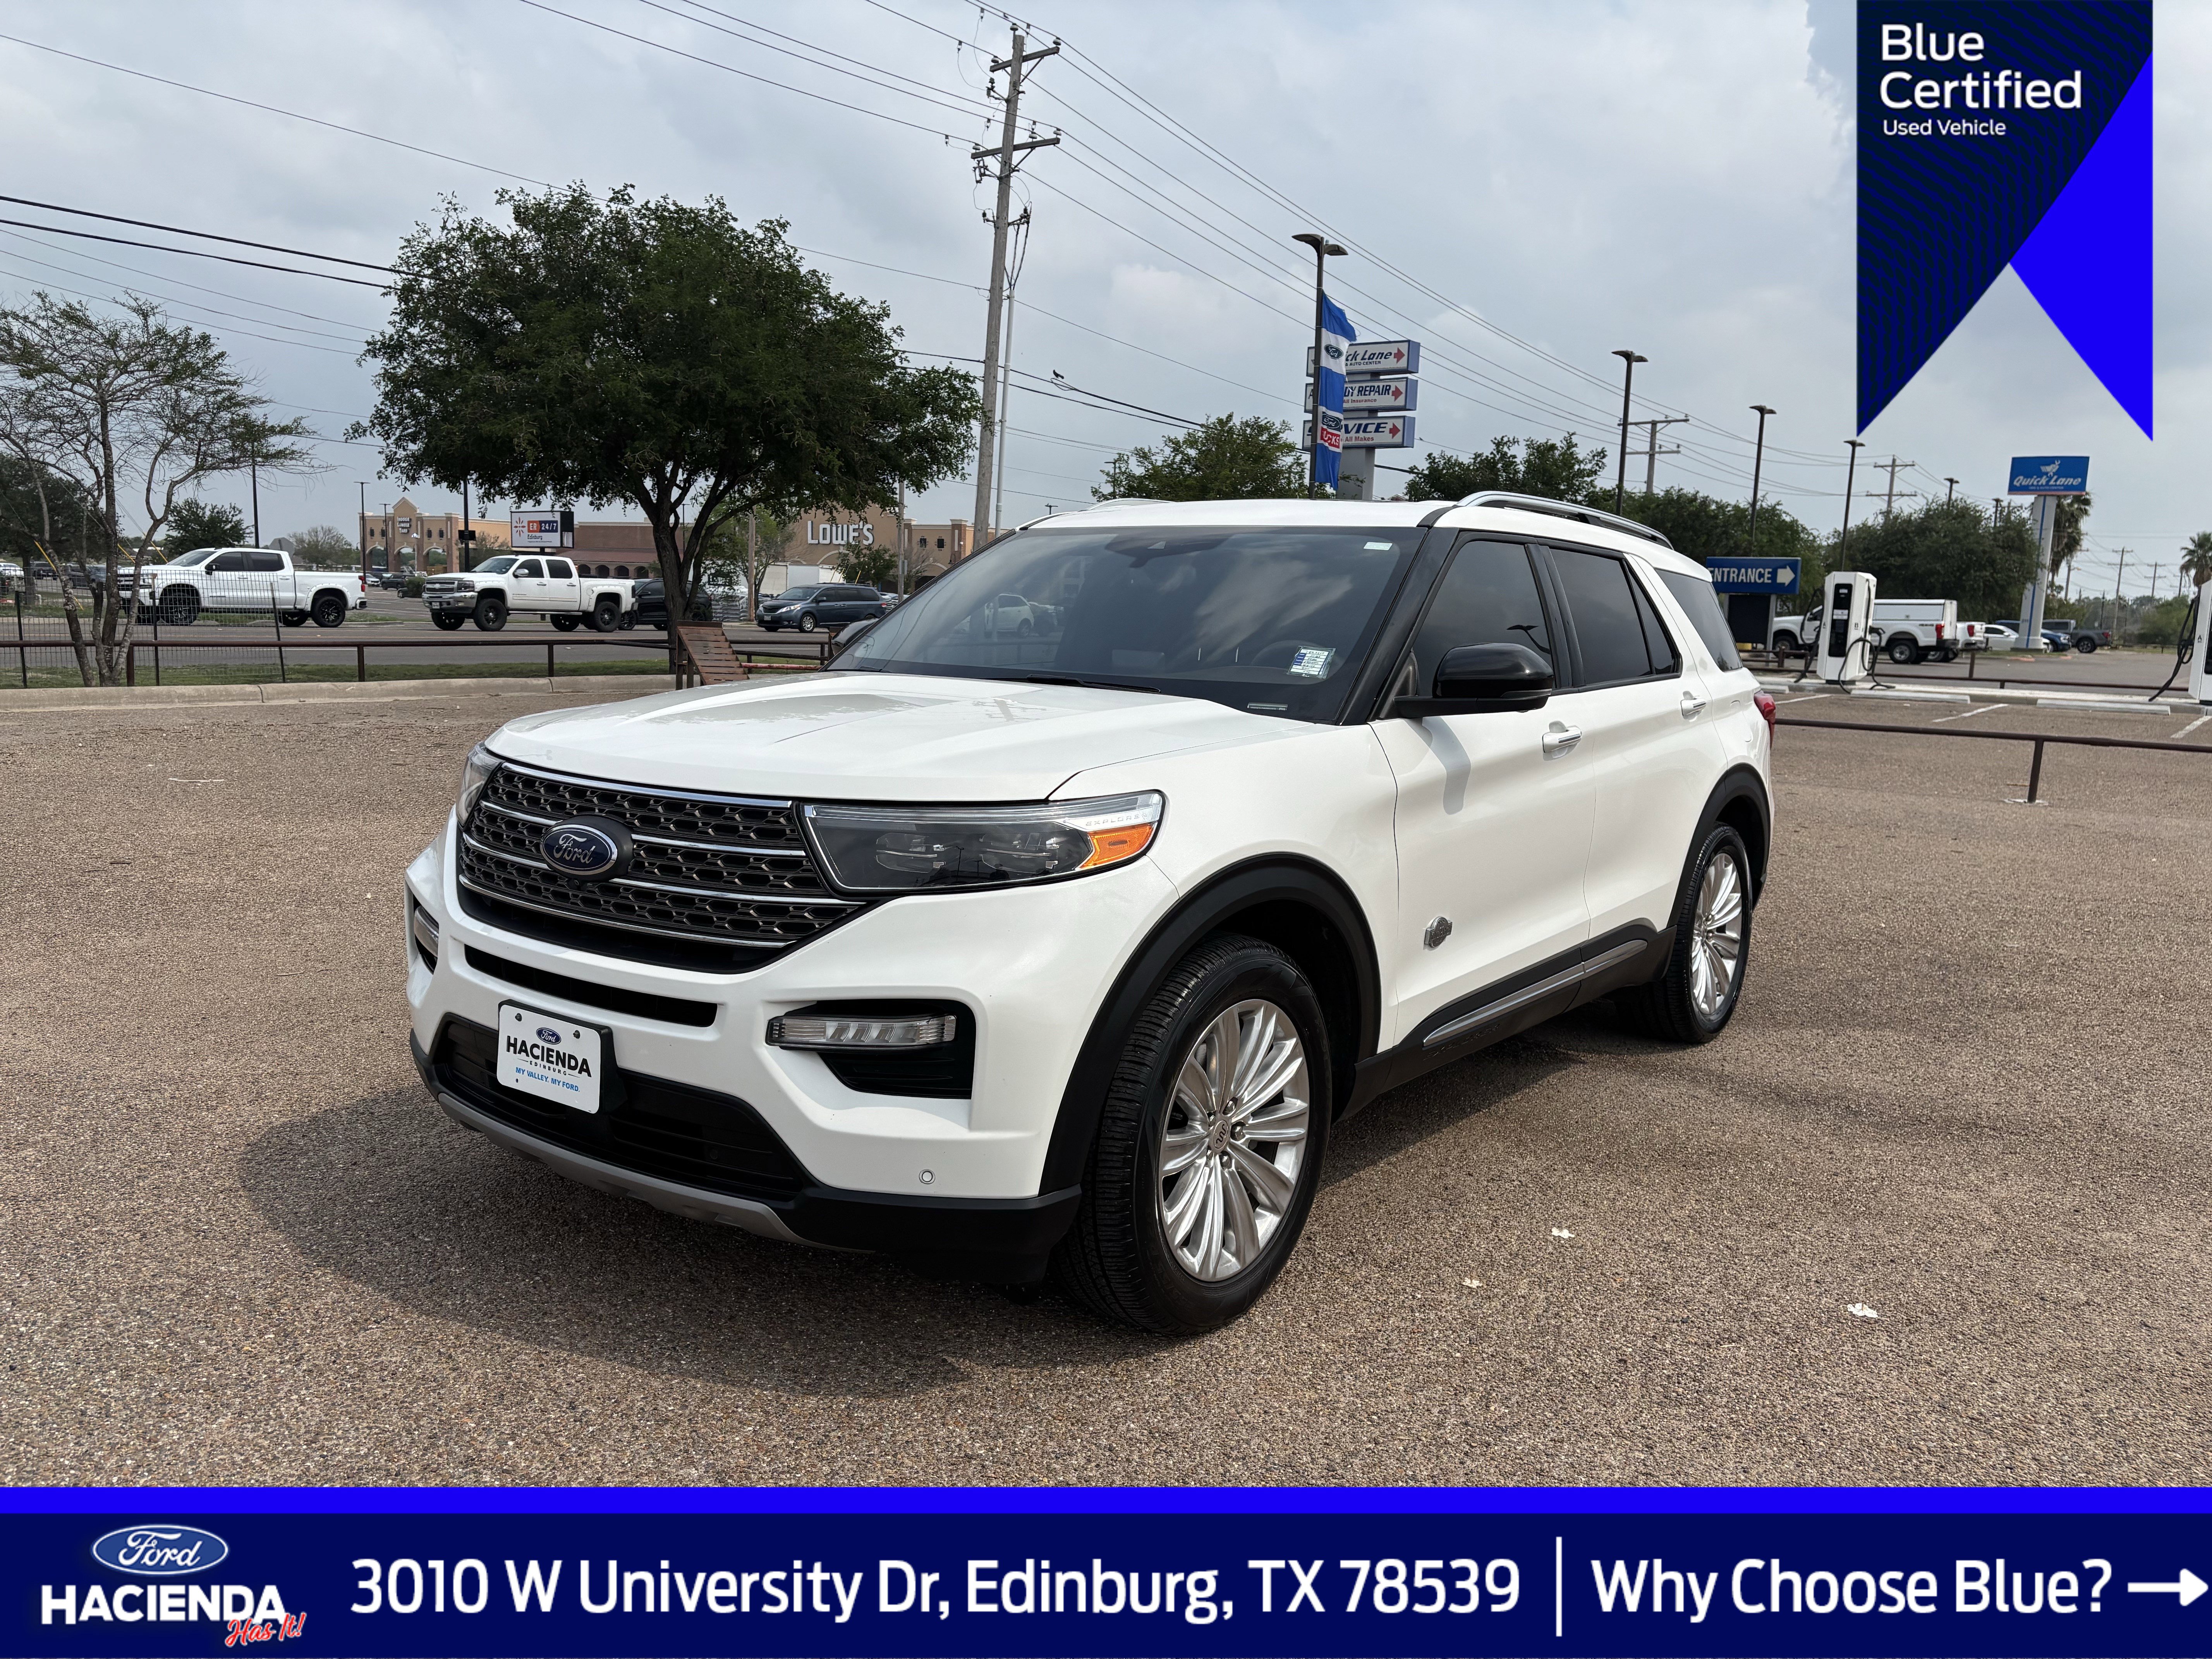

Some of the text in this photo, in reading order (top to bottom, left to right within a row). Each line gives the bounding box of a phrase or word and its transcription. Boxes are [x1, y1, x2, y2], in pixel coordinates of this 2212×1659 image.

[1361, 350, 1393, 361] Lane
[1344, 385, 1391, 397] DY REPAIR
[2014, 475, 2081, 487] Quick Lane
[807, 520, 874, 545] LOWE'S
[1085, 812, 1147, 826] EXPLORER
[553, 833, 596, 864] Ford
[506, 1035, 592, 1078] HACIENDA
[530, 1060, 567, 1076] EDINBURG
[515, 1067, 526, 1075] MY
[551, 1078, 561, 1086] MY
[562, 1082, 580, 1092] FORD.
